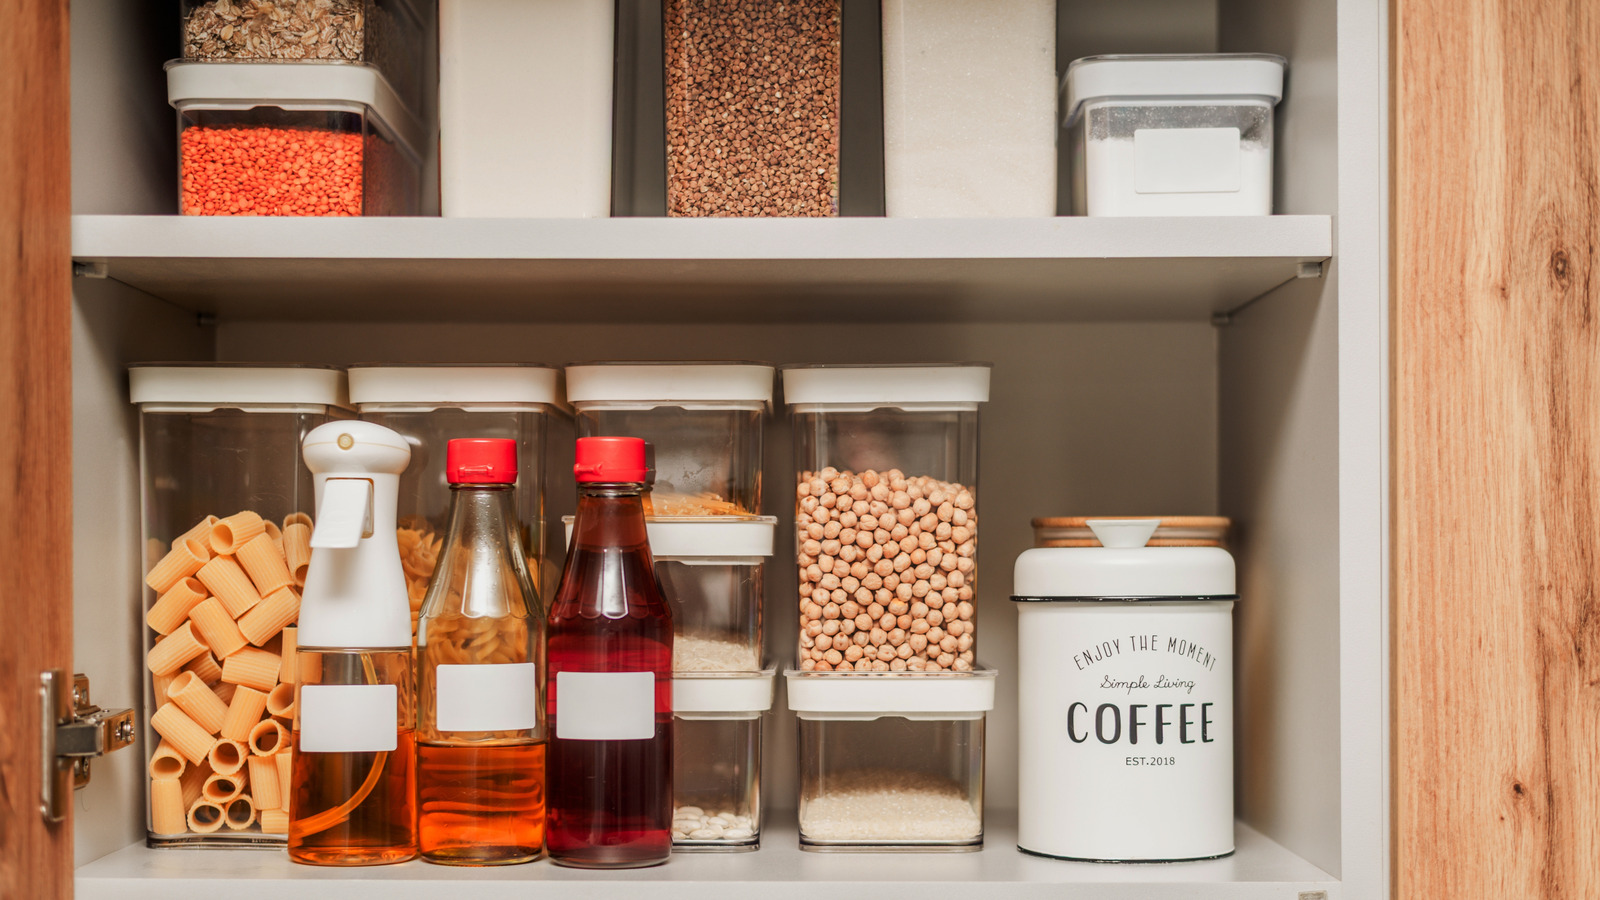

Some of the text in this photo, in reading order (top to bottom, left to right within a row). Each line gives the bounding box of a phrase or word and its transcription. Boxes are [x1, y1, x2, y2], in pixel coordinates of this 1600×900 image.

[1073, 634, 1216, 672] ENJOY THE MOMENT
[1100, 674, 1196, 695] Simple Living
[1067, 701, 1214, 745] COFFEE
[1125, 757, 1176, 766] EST.2018
